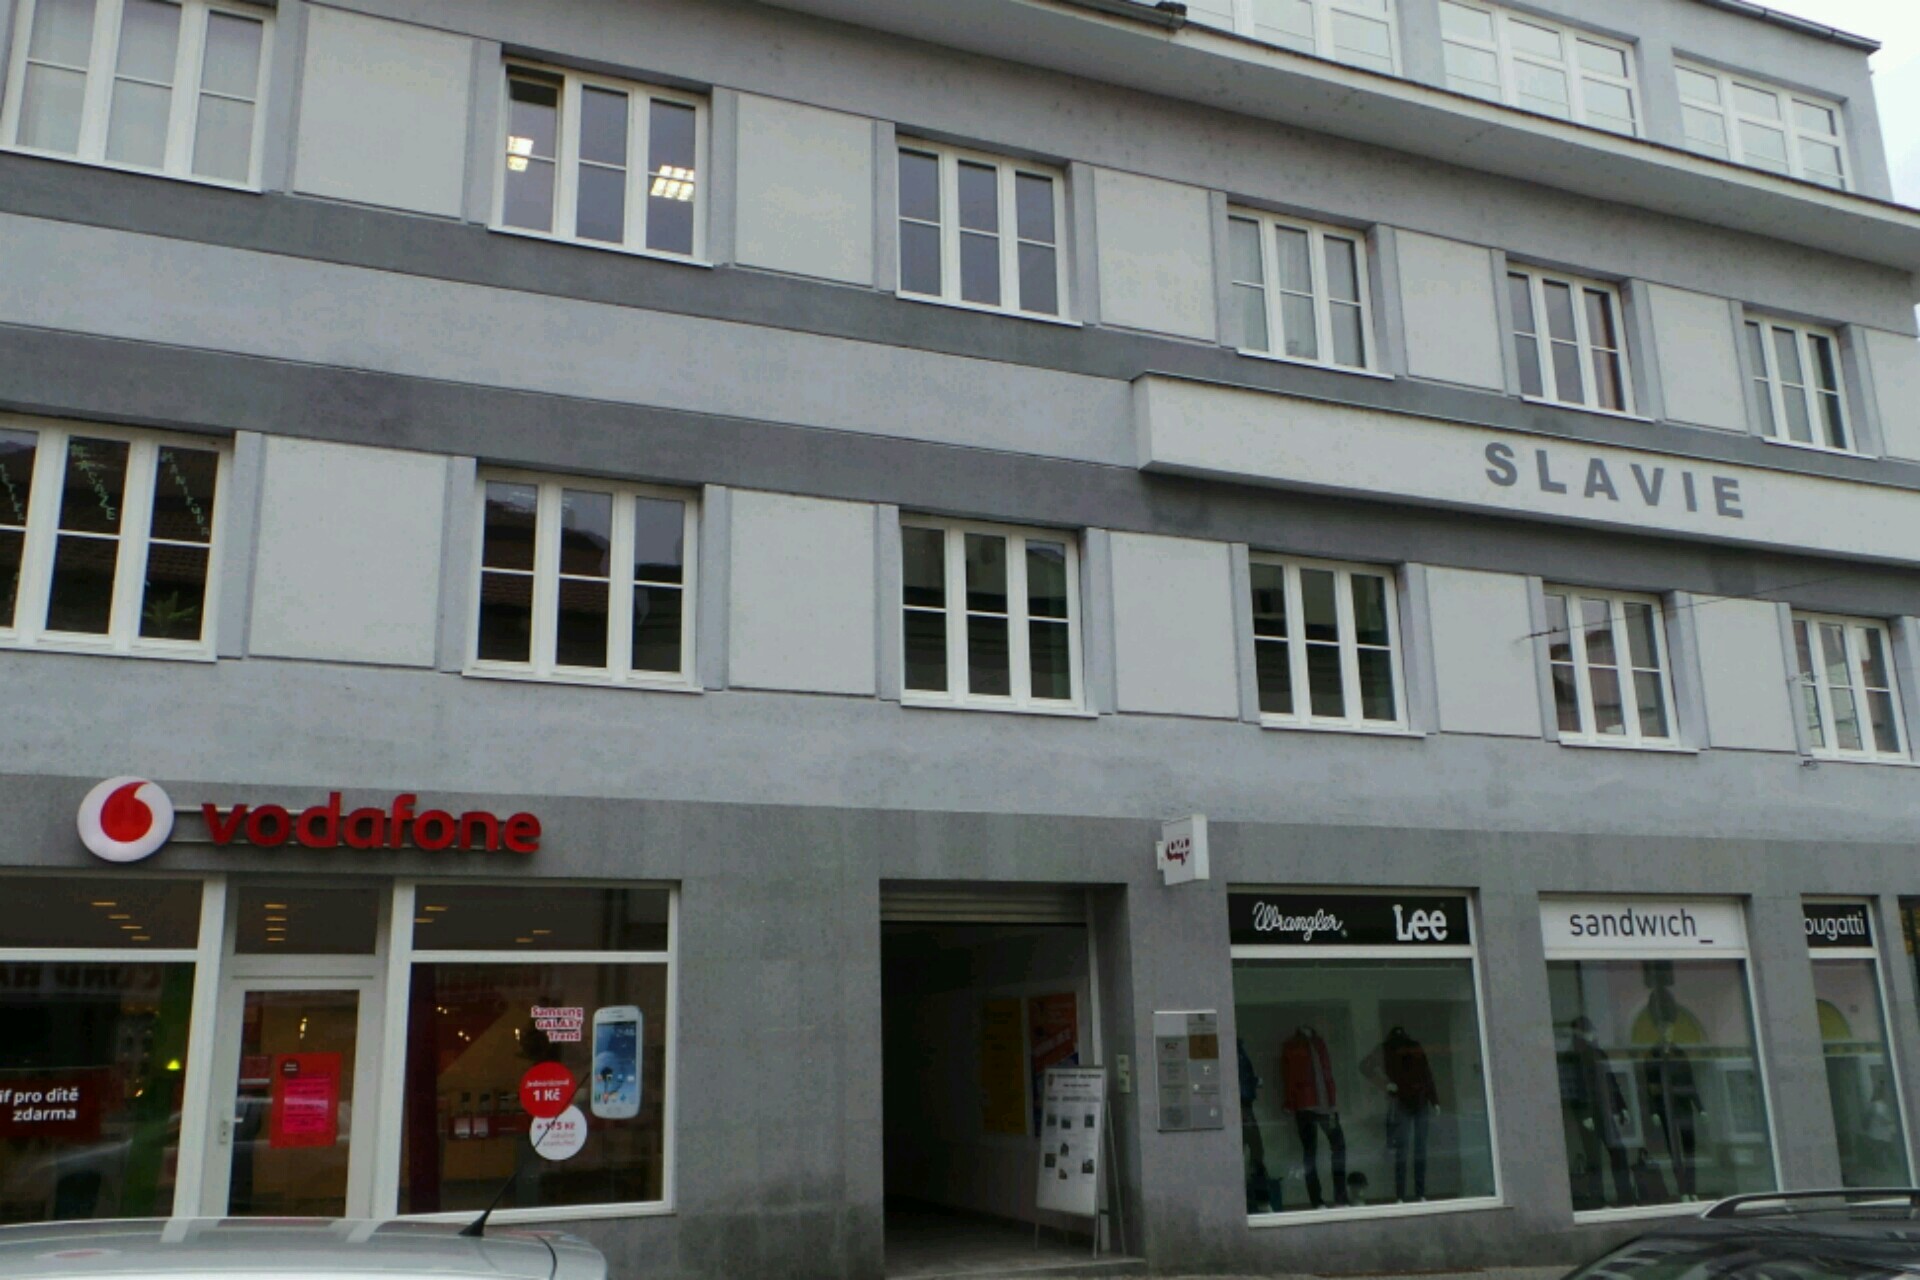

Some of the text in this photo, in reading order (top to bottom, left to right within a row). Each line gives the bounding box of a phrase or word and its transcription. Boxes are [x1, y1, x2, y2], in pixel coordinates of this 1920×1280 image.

[1485, 442, 1744, 519] SLAVIE
[201, 791, 542, 853] vodafone
[1393, 904, 1448, 941] Lee
[532, 1006, 582, 1018] Samsung
[13, 1091, 42, 1107] pro
[45, 1086, 79, 1102] dítě
[532, 1088, 561, 1101] 1 Kč
[12, 1106, 76, 1121] zdarma
